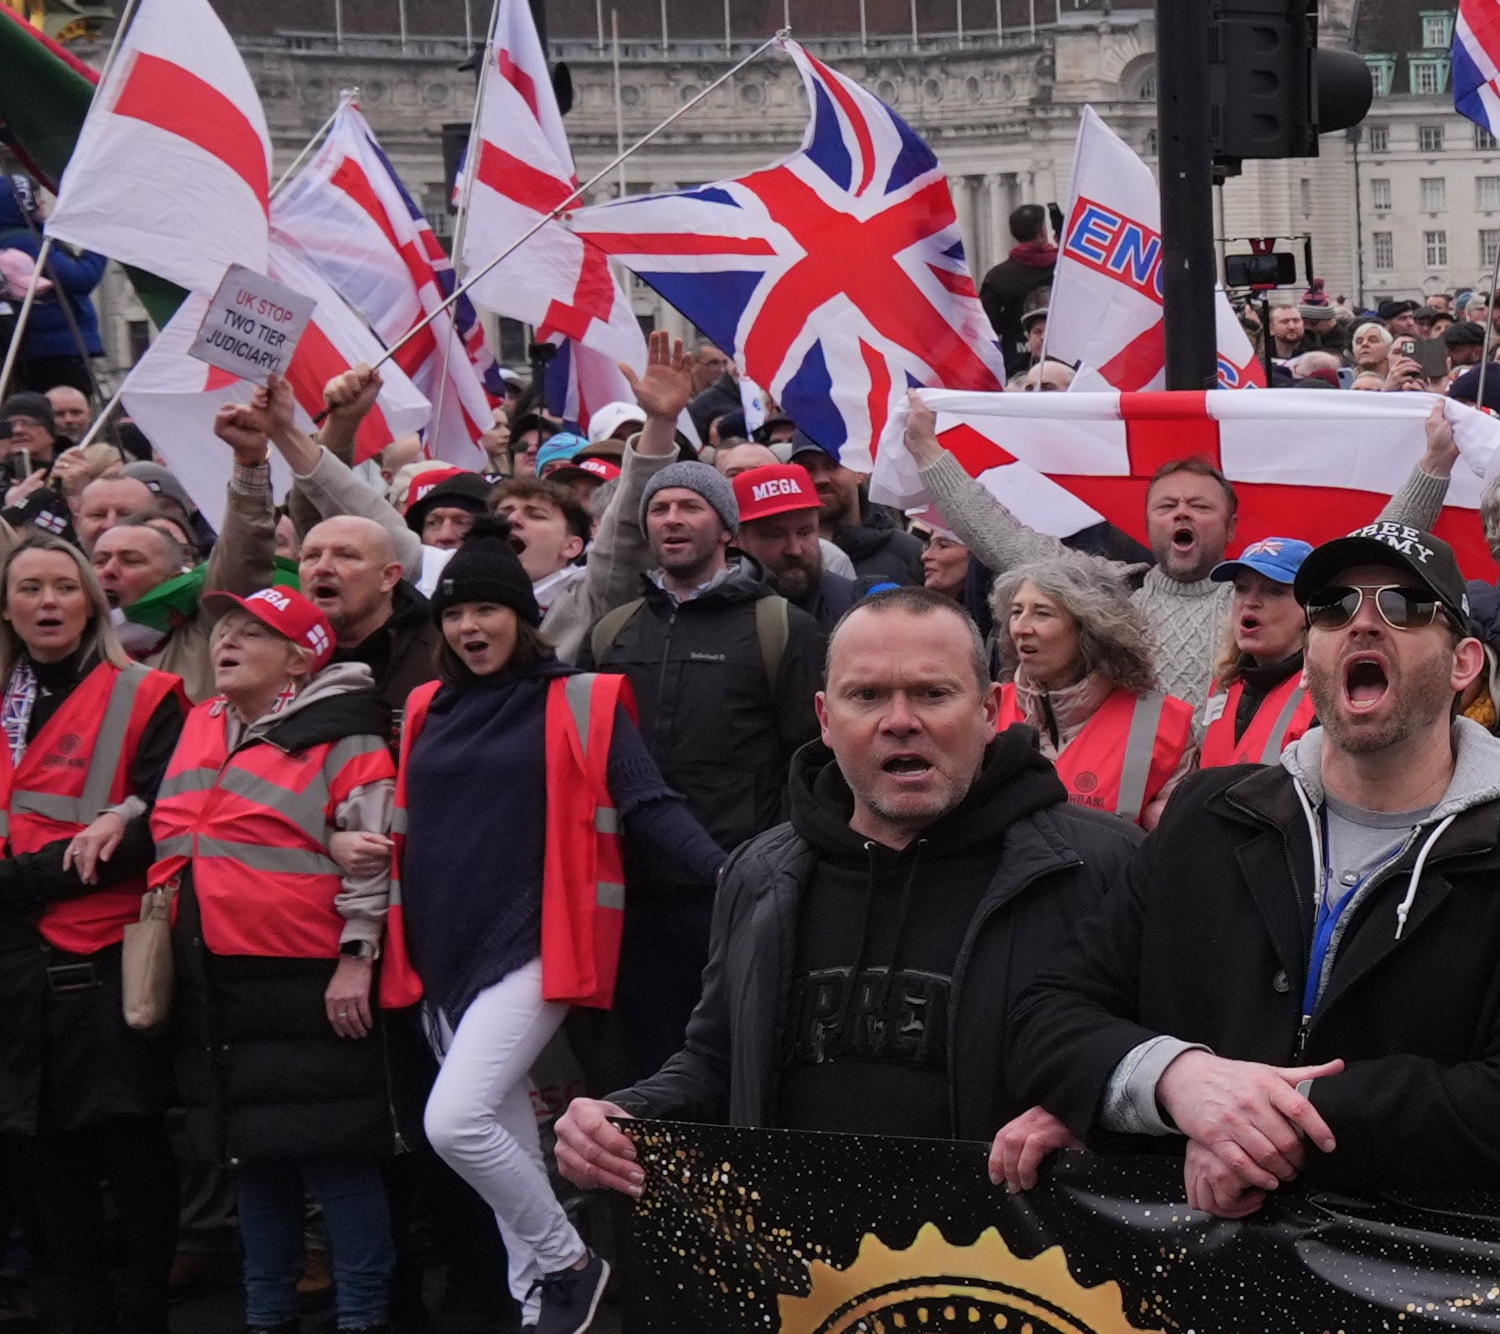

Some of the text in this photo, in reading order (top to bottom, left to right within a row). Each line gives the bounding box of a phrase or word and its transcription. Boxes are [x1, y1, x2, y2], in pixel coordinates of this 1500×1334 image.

[236, 288, 294, 325] UK STOP
[223, 308, 287, 350] TWO TIER
[205, 329, 282, 371] JUDICIARY!
[752, 474, 803, 501] MEGA
